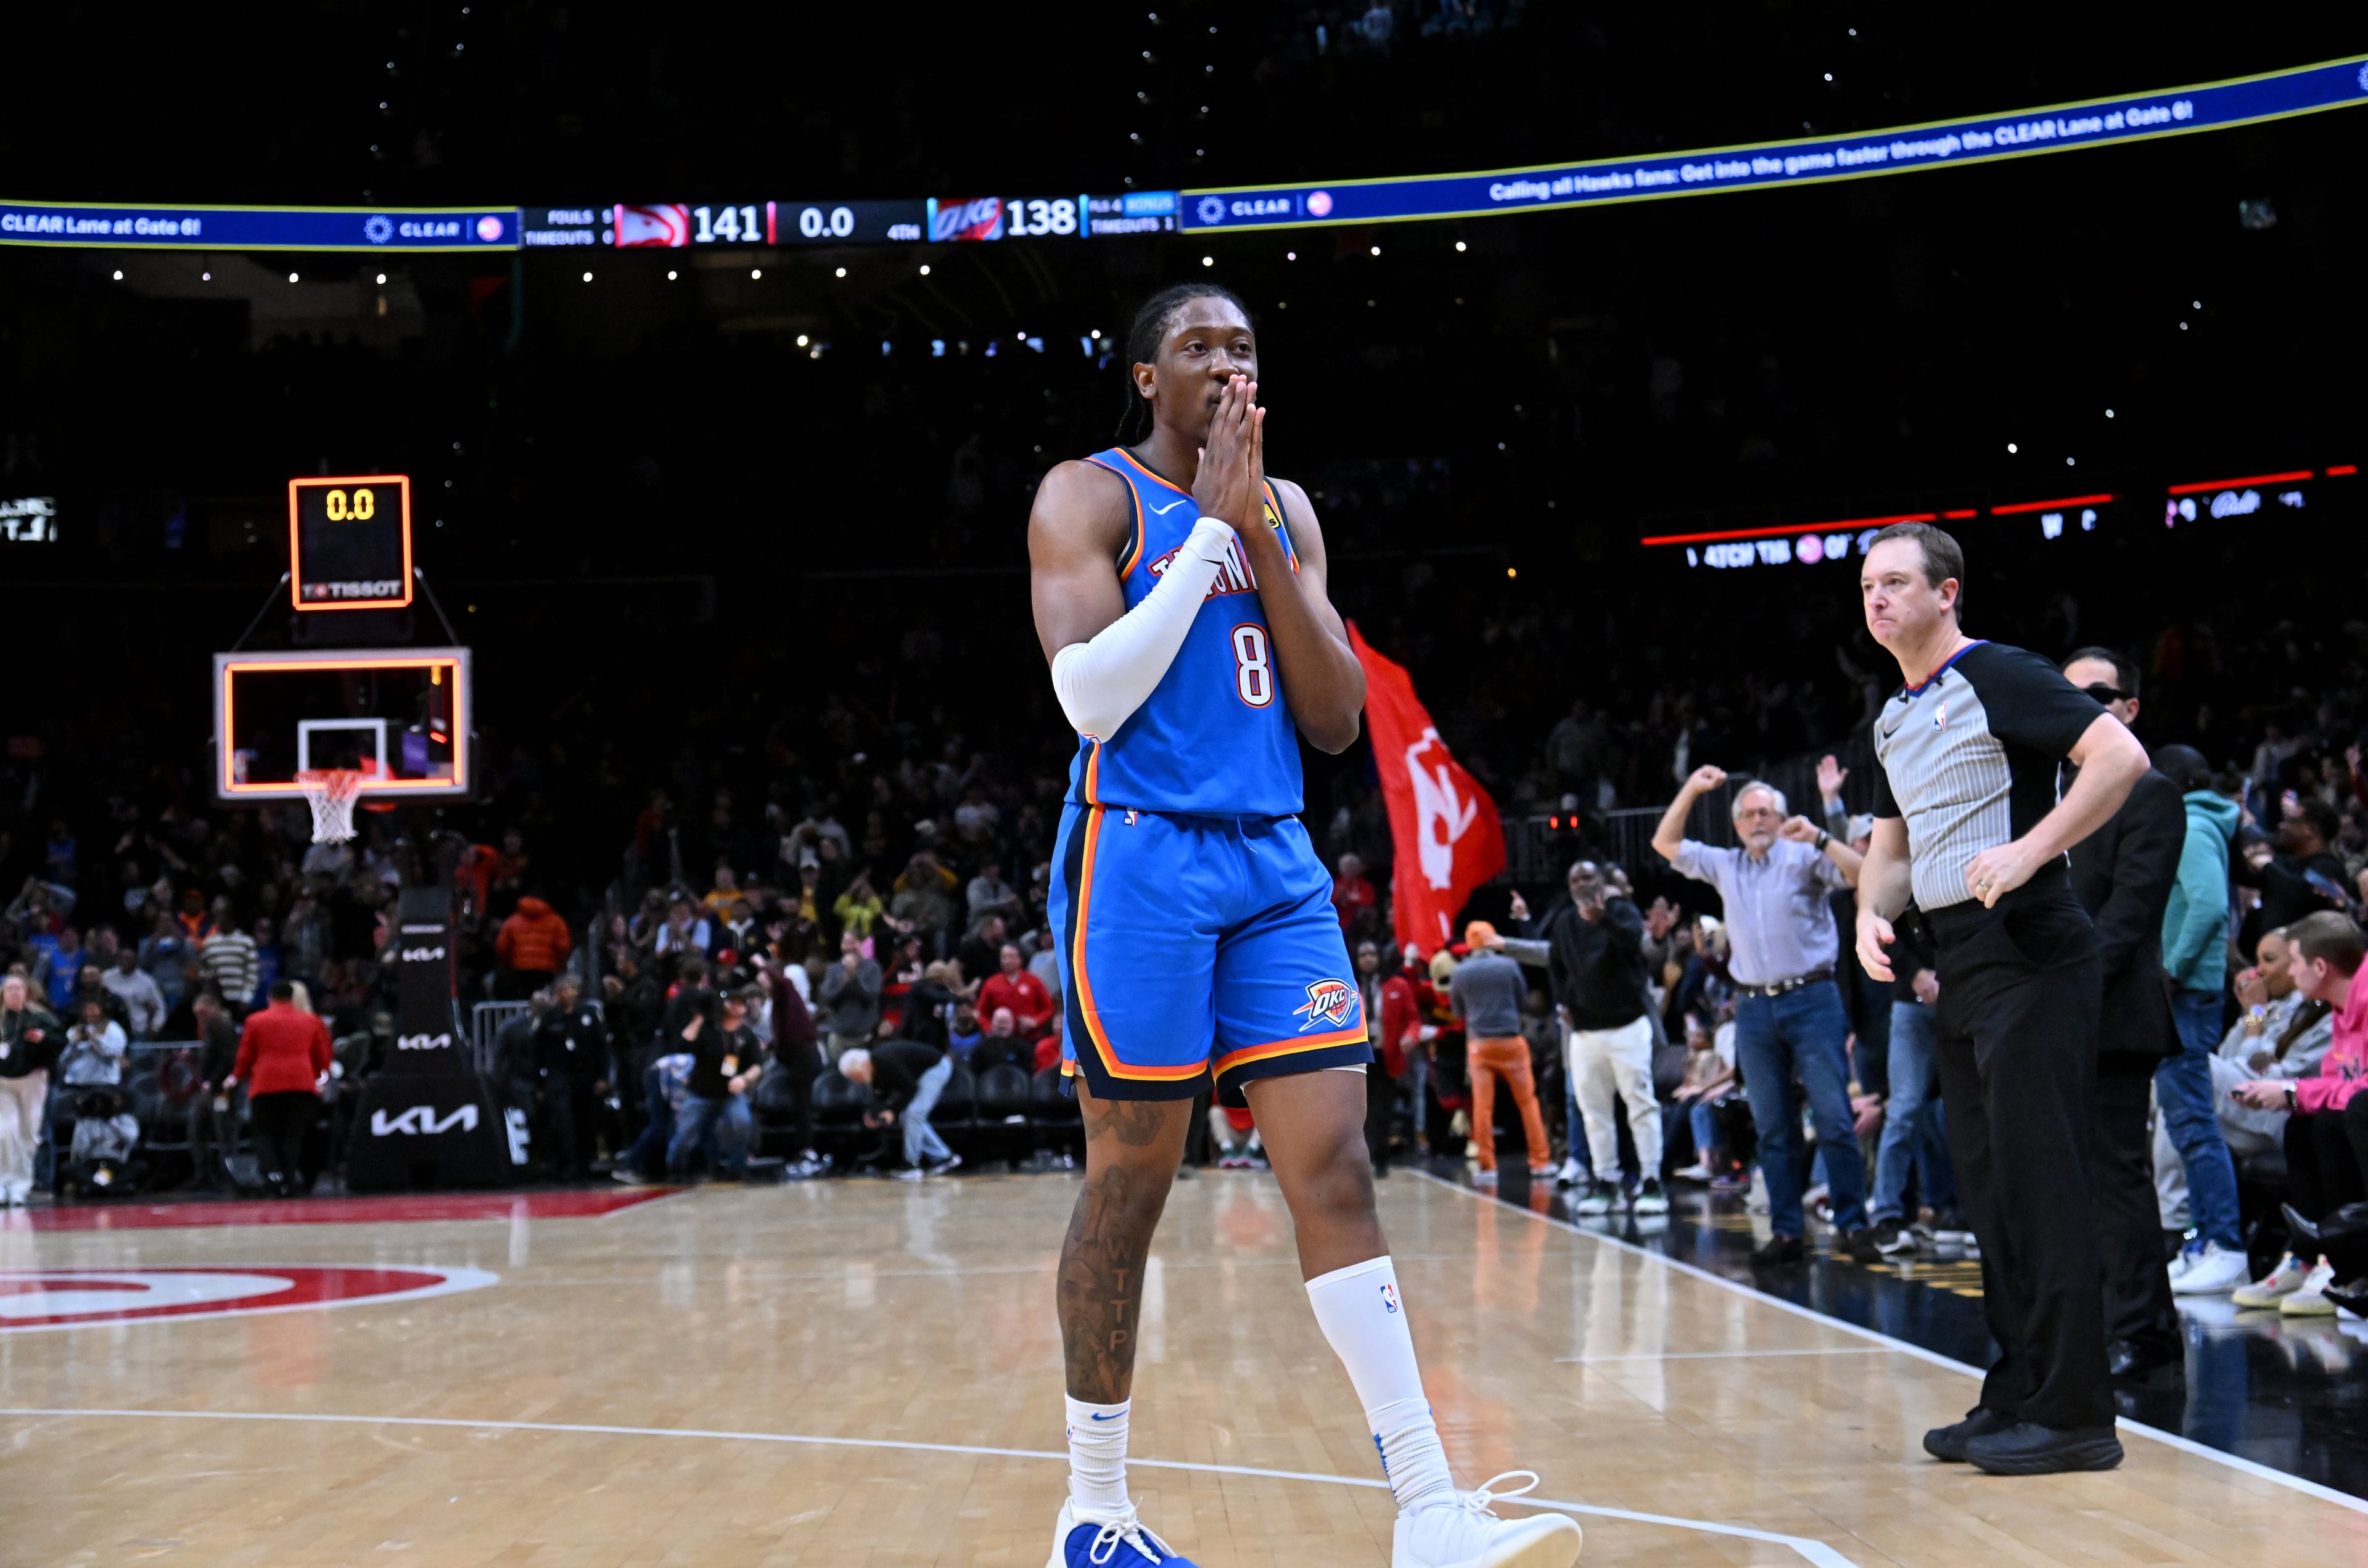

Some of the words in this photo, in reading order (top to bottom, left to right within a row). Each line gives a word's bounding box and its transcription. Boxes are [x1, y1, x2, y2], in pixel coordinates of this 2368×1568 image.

[1490, 181, 1550, 201] Calling
[1552, 178, 1573, 194] all
[1574, 174, 1634, 192] Hawks
[1635, 169, 1680, 186] fans:
[1680, 165, 1714, 182] Get
[1715, 162, 1751, 179] into
[1752, 157, 1783, 174] the
[1785, 153, 1835, 175] game
[1837, 147, 1889, 166] faster
[1890, 136, 1961, 158] through
[1962, 131, 1993, 149] the
[1994, 120, 2057, 145] CLEAR
[2057, 117, 2103, 137] Lane
[2105, 112, 2124, 129] at
[2126, 107, 2171, 126] Gate
[2172, 101, 2193, 120] 6!
[1126, 197, 1174, 213] BONUS
[1231, 199, 1290, 216] CLEAR
[1, 213, 64, 233] CLEAR
[66, 216, 112, 234] Lane
[113, 218, 133, 234] at
[134, 217, 179, 236] Gate
[181, 218, 201, 236] 6!
[548, 210, 594, 225] FOULS
[694, 206, 761, 242] 141
[800, 207, 854, 237] 0.0
[1007, 199, 1077, 236] 138
[1090, 217, 1160, 234] TIMEOUTS
[400, 222, 459, 237] CLEAR
[525, 229, 595, 245] TIMEOUTS
[887, 224, 920, 240] 4TH
[326, 488, 374, 521] 0.0
[328, 580, 402, 598] TISSOT
[1231, 623, 1274, 708] 8
[401, 946, 445, 962] KIA
[1312, 988, 1345, 1017] OKC
[397, 1033, 451, 1050] KIA
[371, 1104, 478, 1136] KIA
